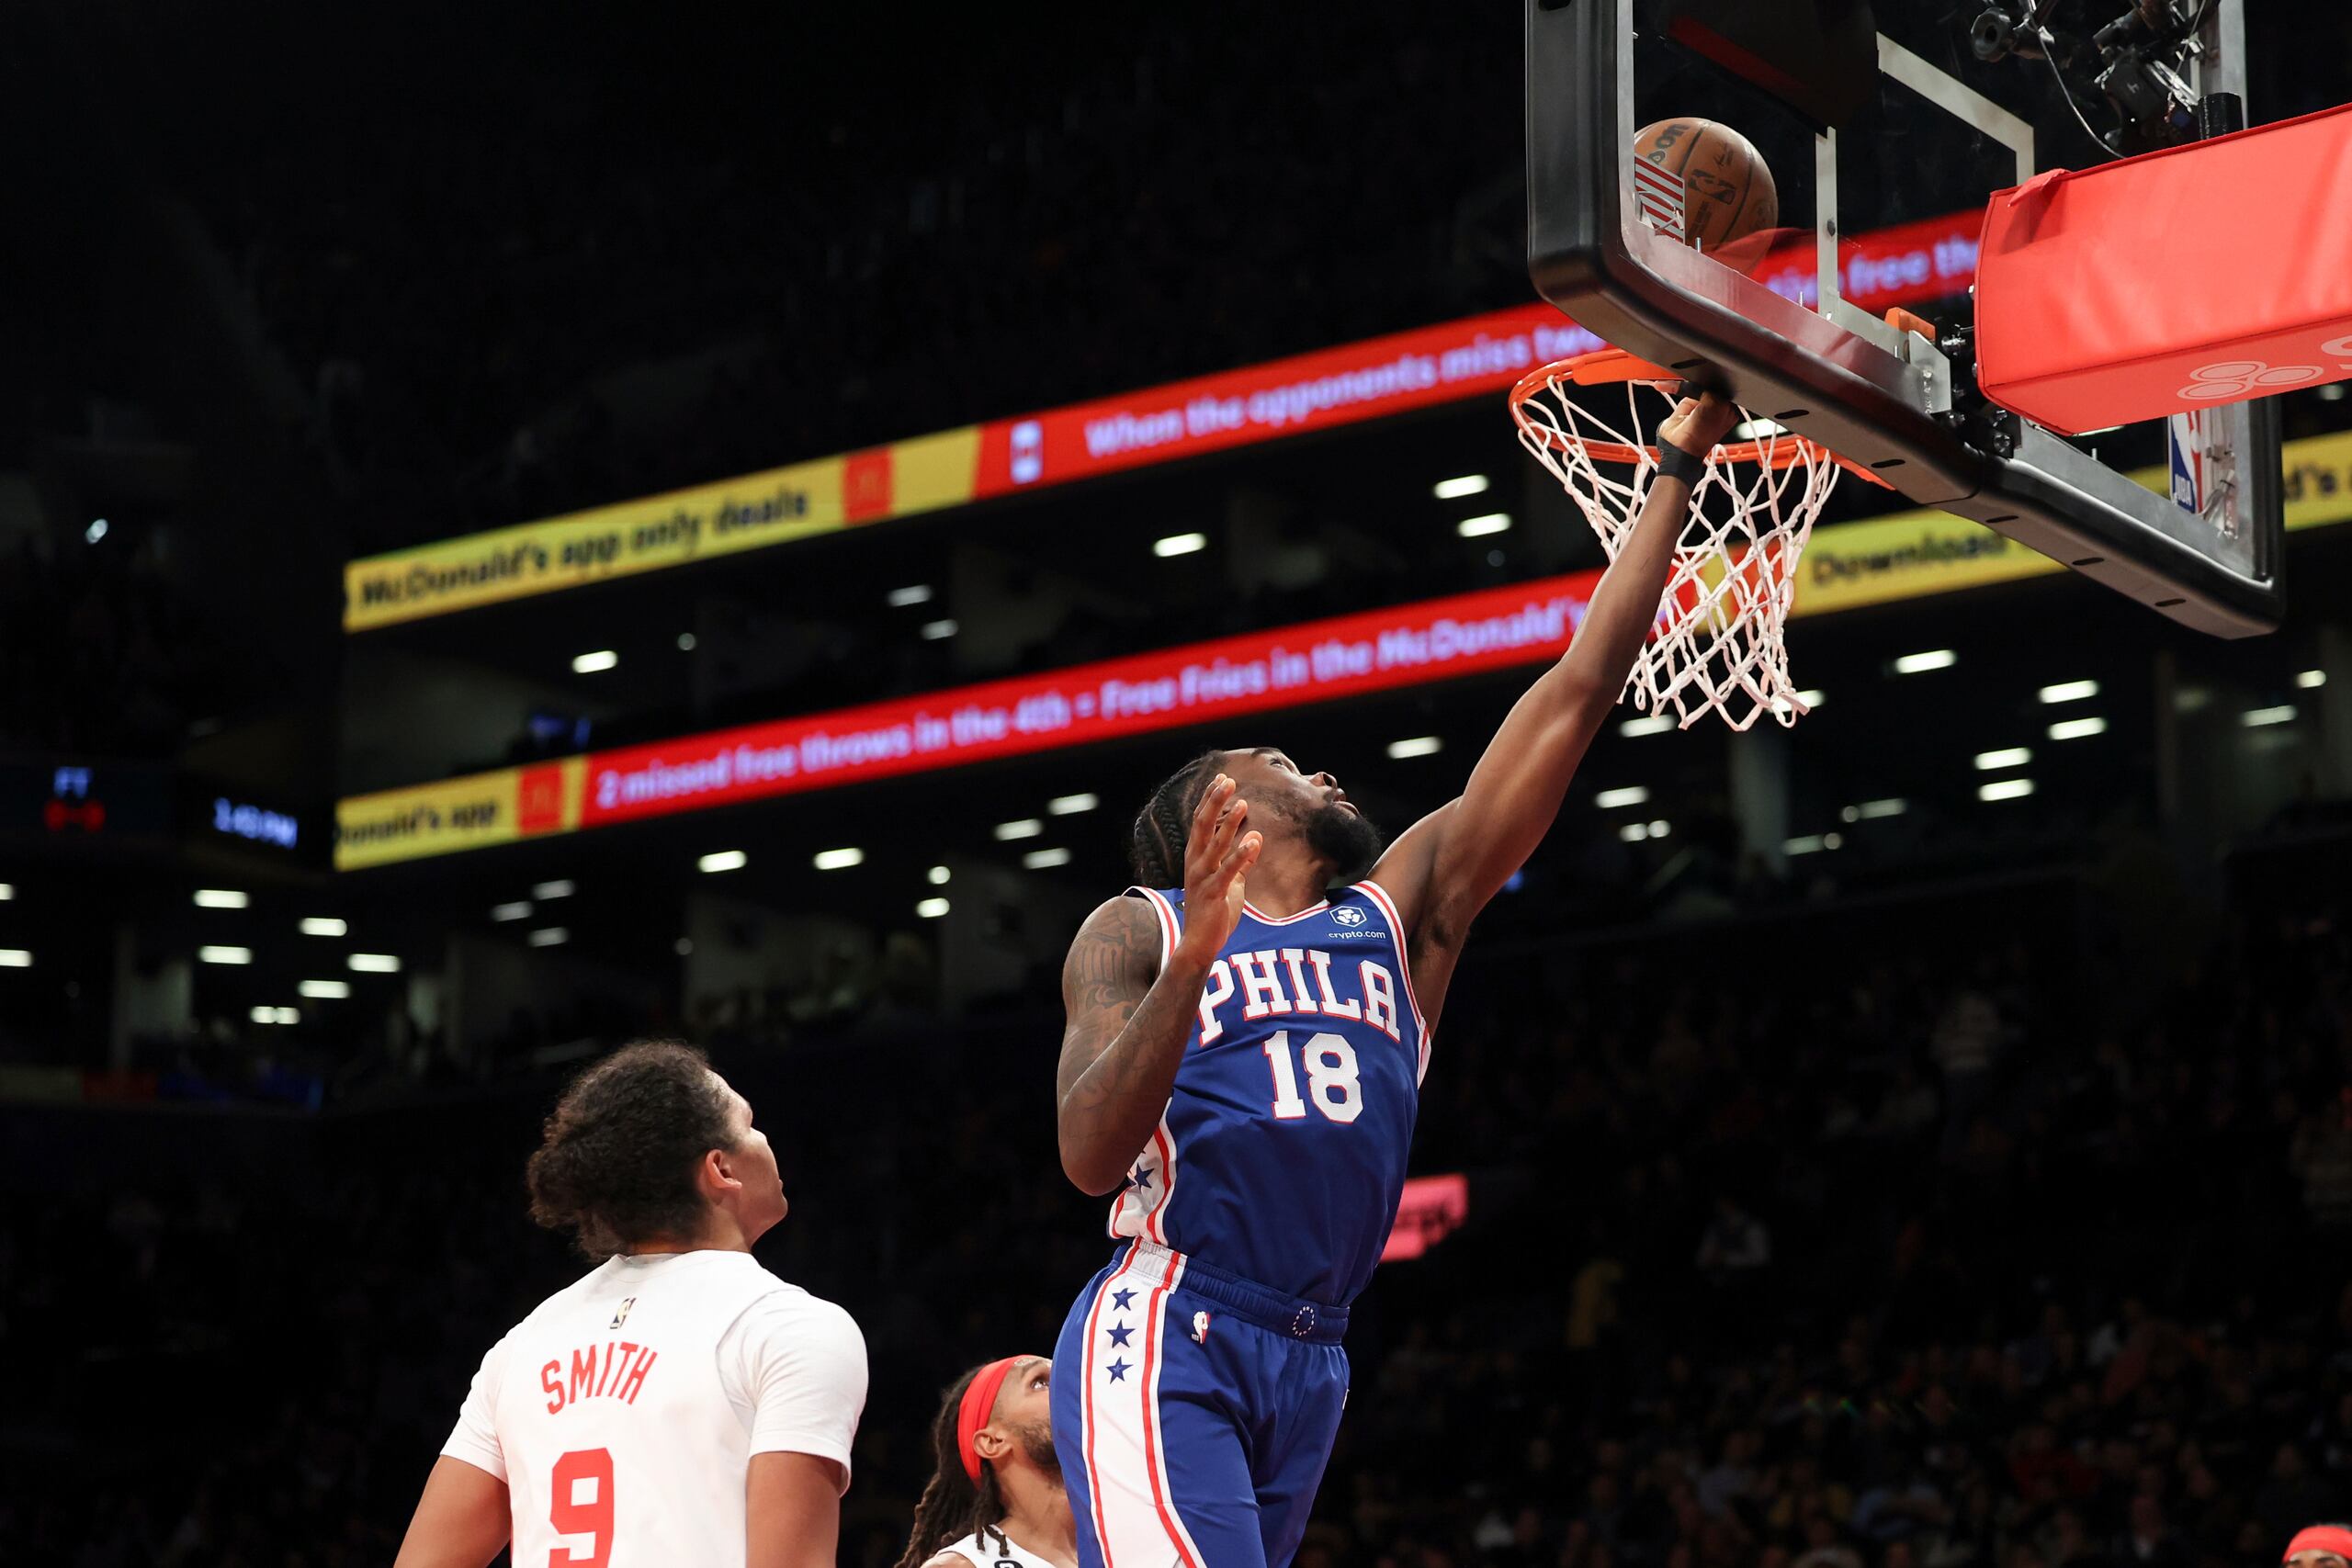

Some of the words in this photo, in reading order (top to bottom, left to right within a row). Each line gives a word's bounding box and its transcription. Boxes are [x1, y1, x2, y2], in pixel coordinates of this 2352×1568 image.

[1847, 254, 1929, 298] free
[1086, 412, 1185, 457] When
[1186, 396, 1246, 436] the
[1248, 353, 1439, 427] opponents
[1440, 333, 1532, 381] miss
[362, 542, 547, 606] McDonald's
[561, 532, 622, 581] app
[632, 509, 702, 556] only
[715, 488, 808, 535] deals
[597, 770, 619, 809] 2
[620, 749, 734, 805] missed
[735, 742, 798, 785] free
[800, 730, 912, 774] throws
[914, 712, 950, 754] in
[951, 705, 1009, 747] the
[1012, 691, 1071, 733] 4th
[1100, 679, 1177, 720] Free
[1180, 656, 1268, 705] Fries
[1271, 647, 1308, 690] in
[1311, 637, 1373, 682] the
[452, 800, 498, 832] app
[1328, 930, 1386, 940] crypto.com
[1198, 948, 1401, 1047] PHILA
[1262, 1030, 1363, 1124] 18
[541, 1341, 658, 1415] SMITH
[548, 1447, 615, 1568] 9
